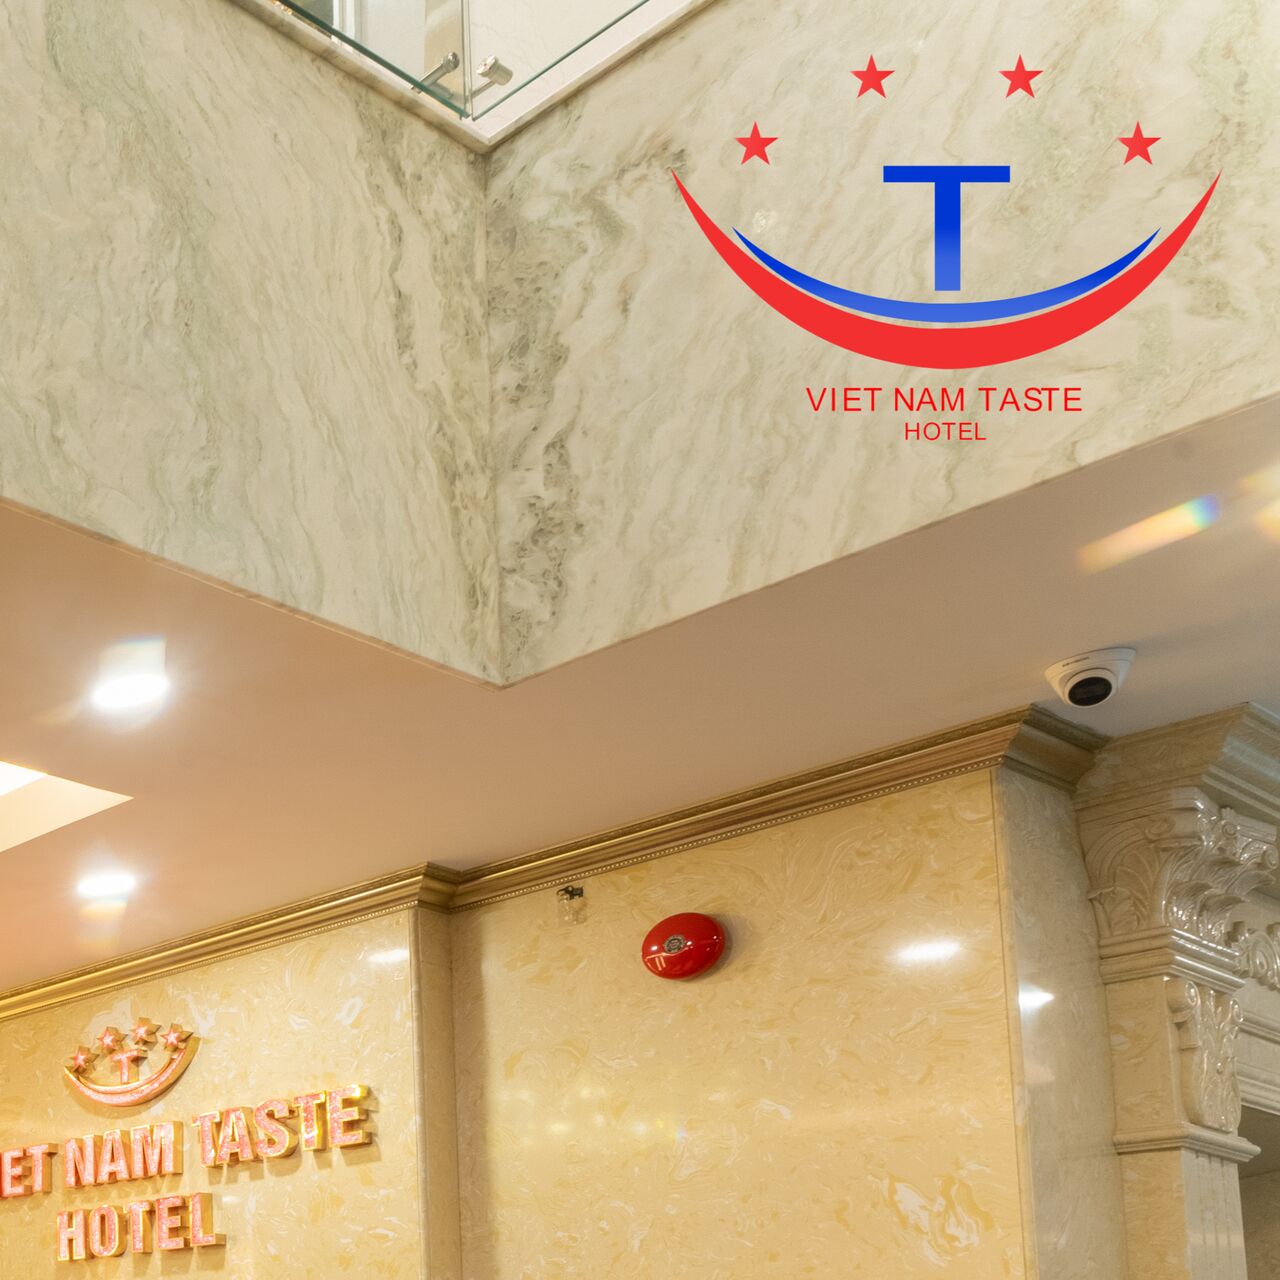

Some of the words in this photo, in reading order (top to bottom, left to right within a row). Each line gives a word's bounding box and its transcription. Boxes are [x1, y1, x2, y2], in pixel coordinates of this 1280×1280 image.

[64, 1120, 182, 1188] NAM
[192, 1084, 371, 1168] TASTE
[56, 1193, 226, 1261] HOTEL
